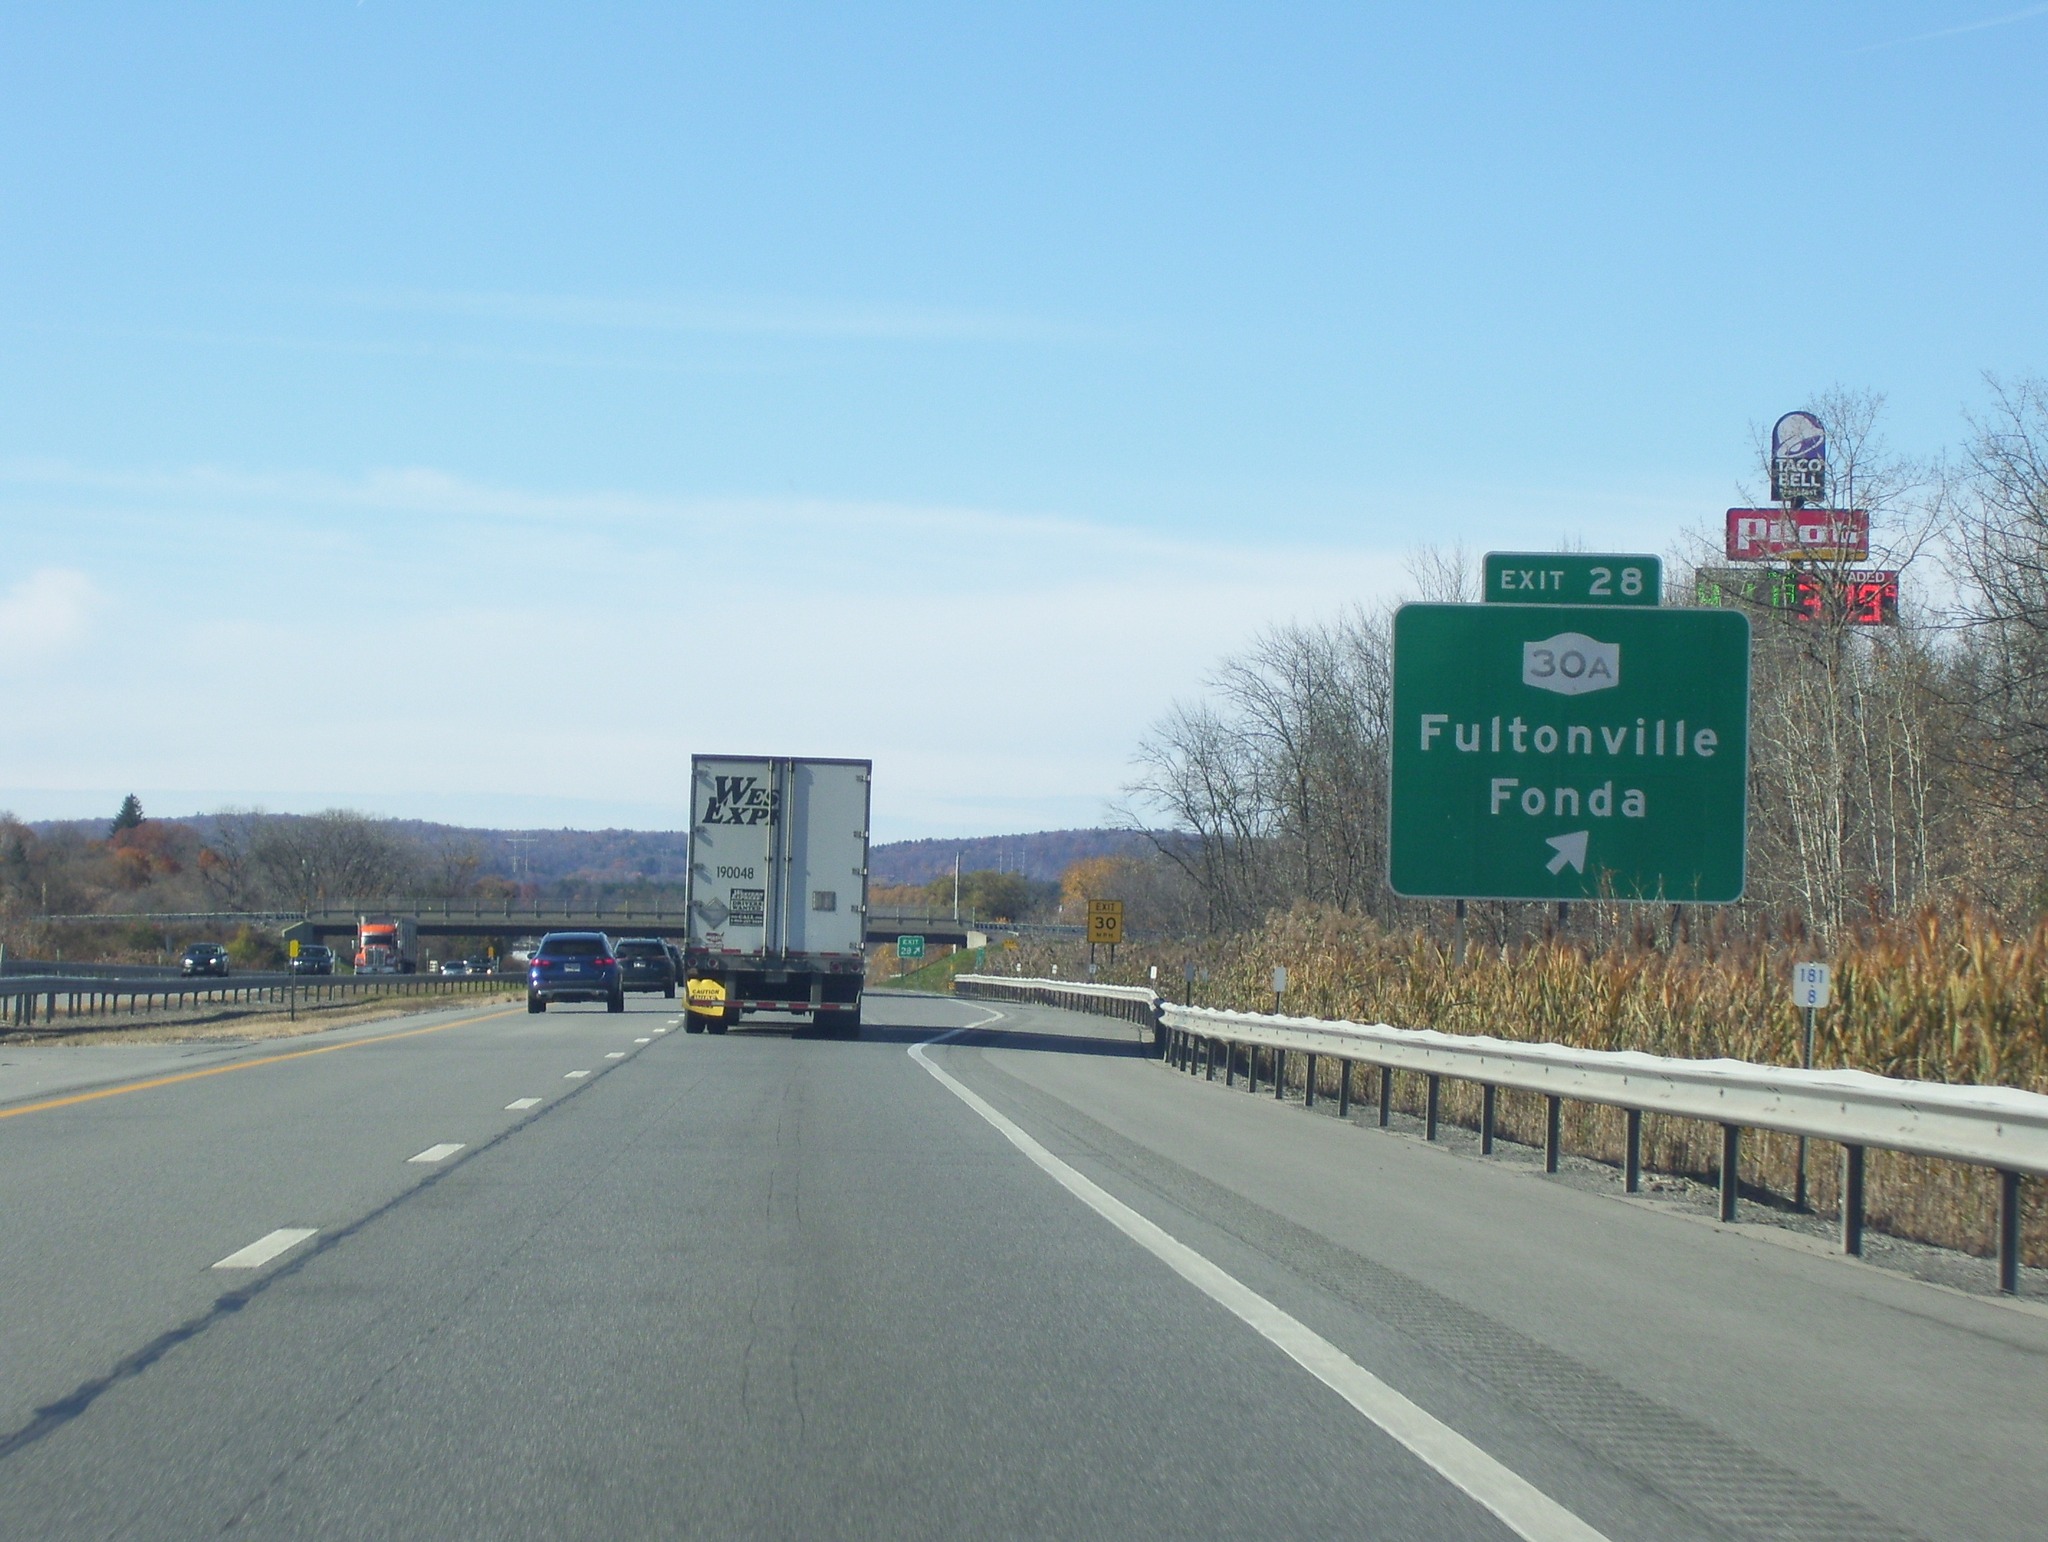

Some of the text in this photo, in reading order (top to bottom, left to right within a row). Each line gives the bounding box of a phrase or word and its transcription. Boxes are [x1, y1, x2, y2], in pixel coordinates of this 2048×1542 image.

[1776, 459, 1821, 472] TACO
[1779, 472, 1820, 487] BELL
[1501, 567, 1643, 596] EXIT 28
[1530, 650, 1611, 678] 30A
[1421, 714, 1718, 757] Fultonville
[1491, 778, 1646, 817] Fonda
[717, 866, 754, 880] 190048
[1096, 903, 1115, 911] EXIT
[1095, 917, 1116, 930] 30
[1801, 968, 1823, 983] 181
